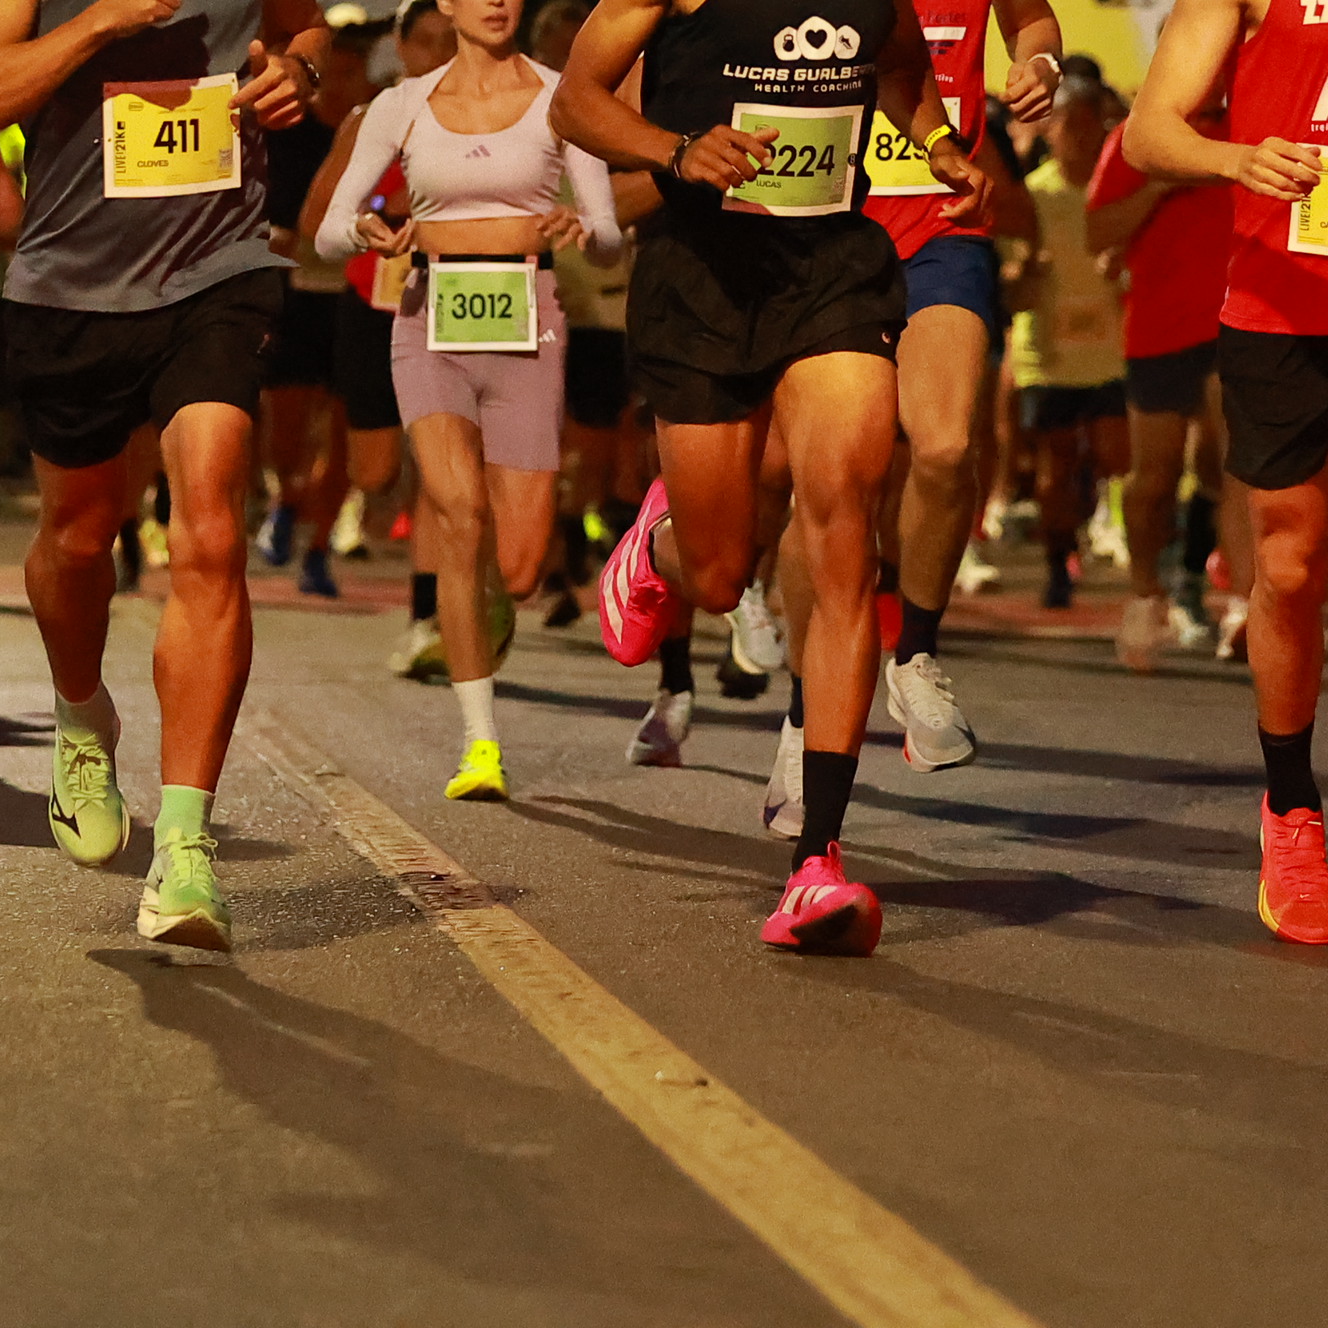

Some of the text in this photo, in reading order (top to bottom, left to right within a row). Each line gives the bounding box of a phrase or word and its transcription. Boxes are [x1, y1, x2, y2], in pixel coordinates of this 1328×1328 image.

[723, 63, 790, 81] LUCAS
[755, 83, 805, 93] HEALTH
[153, 118, 200, 154] 411
[876, 132, 924, 161] 82
[756, 179, 782, 189] LUCAS
[452, 293, 512, 320] 3012
